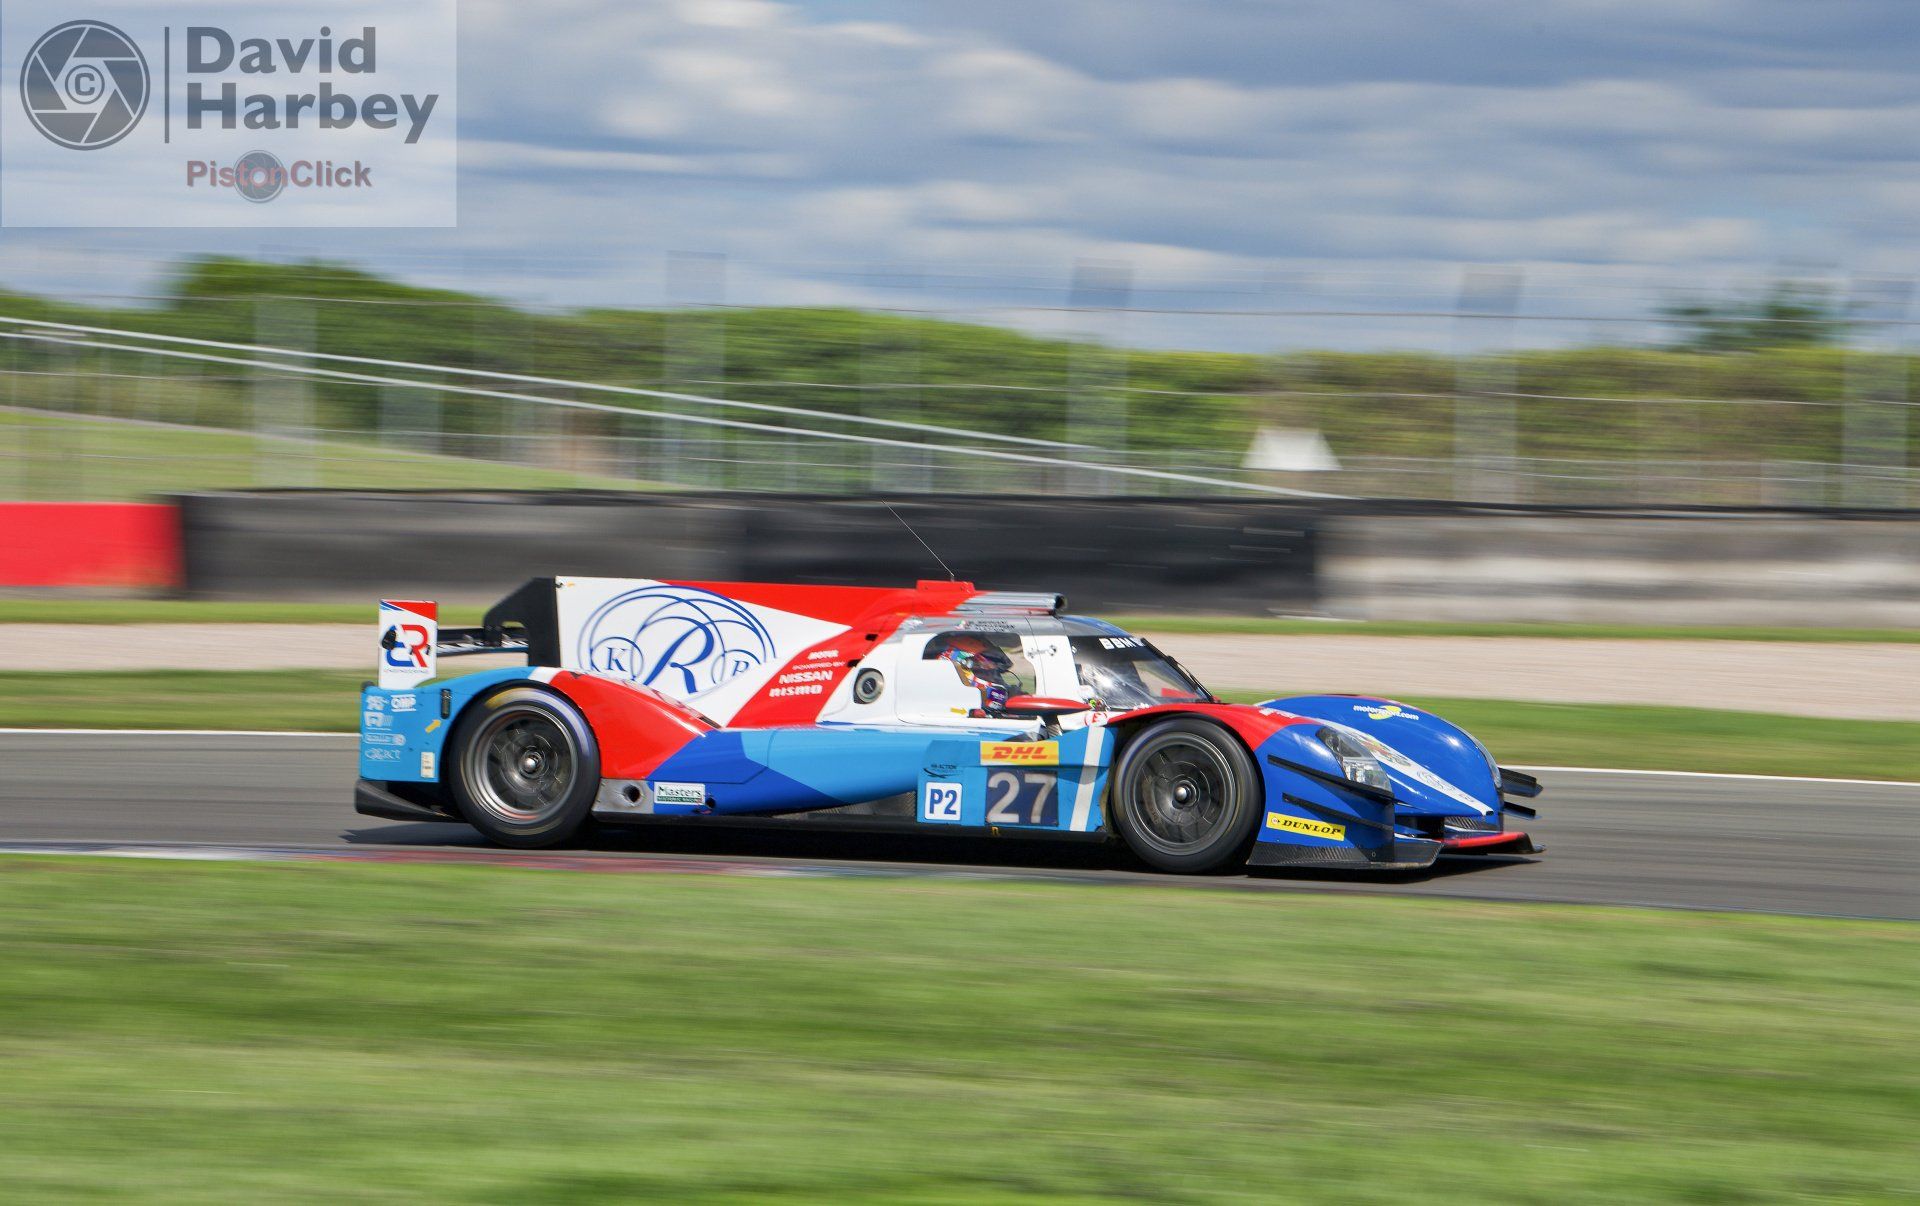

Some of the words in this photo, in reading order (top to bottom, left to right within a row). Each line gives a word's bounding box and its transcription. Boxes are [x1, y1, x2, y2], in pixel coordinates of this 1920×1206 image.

[779, 670, 834, 684] NISSAN
[992, 747, 1048, 759] DHL
[658, 785, 702, 798] Masters
[986, 772, 1056, 824] 27
[929, 789, 957, 814] P2
[1283, 820, 1341, 834] DUNLOP
